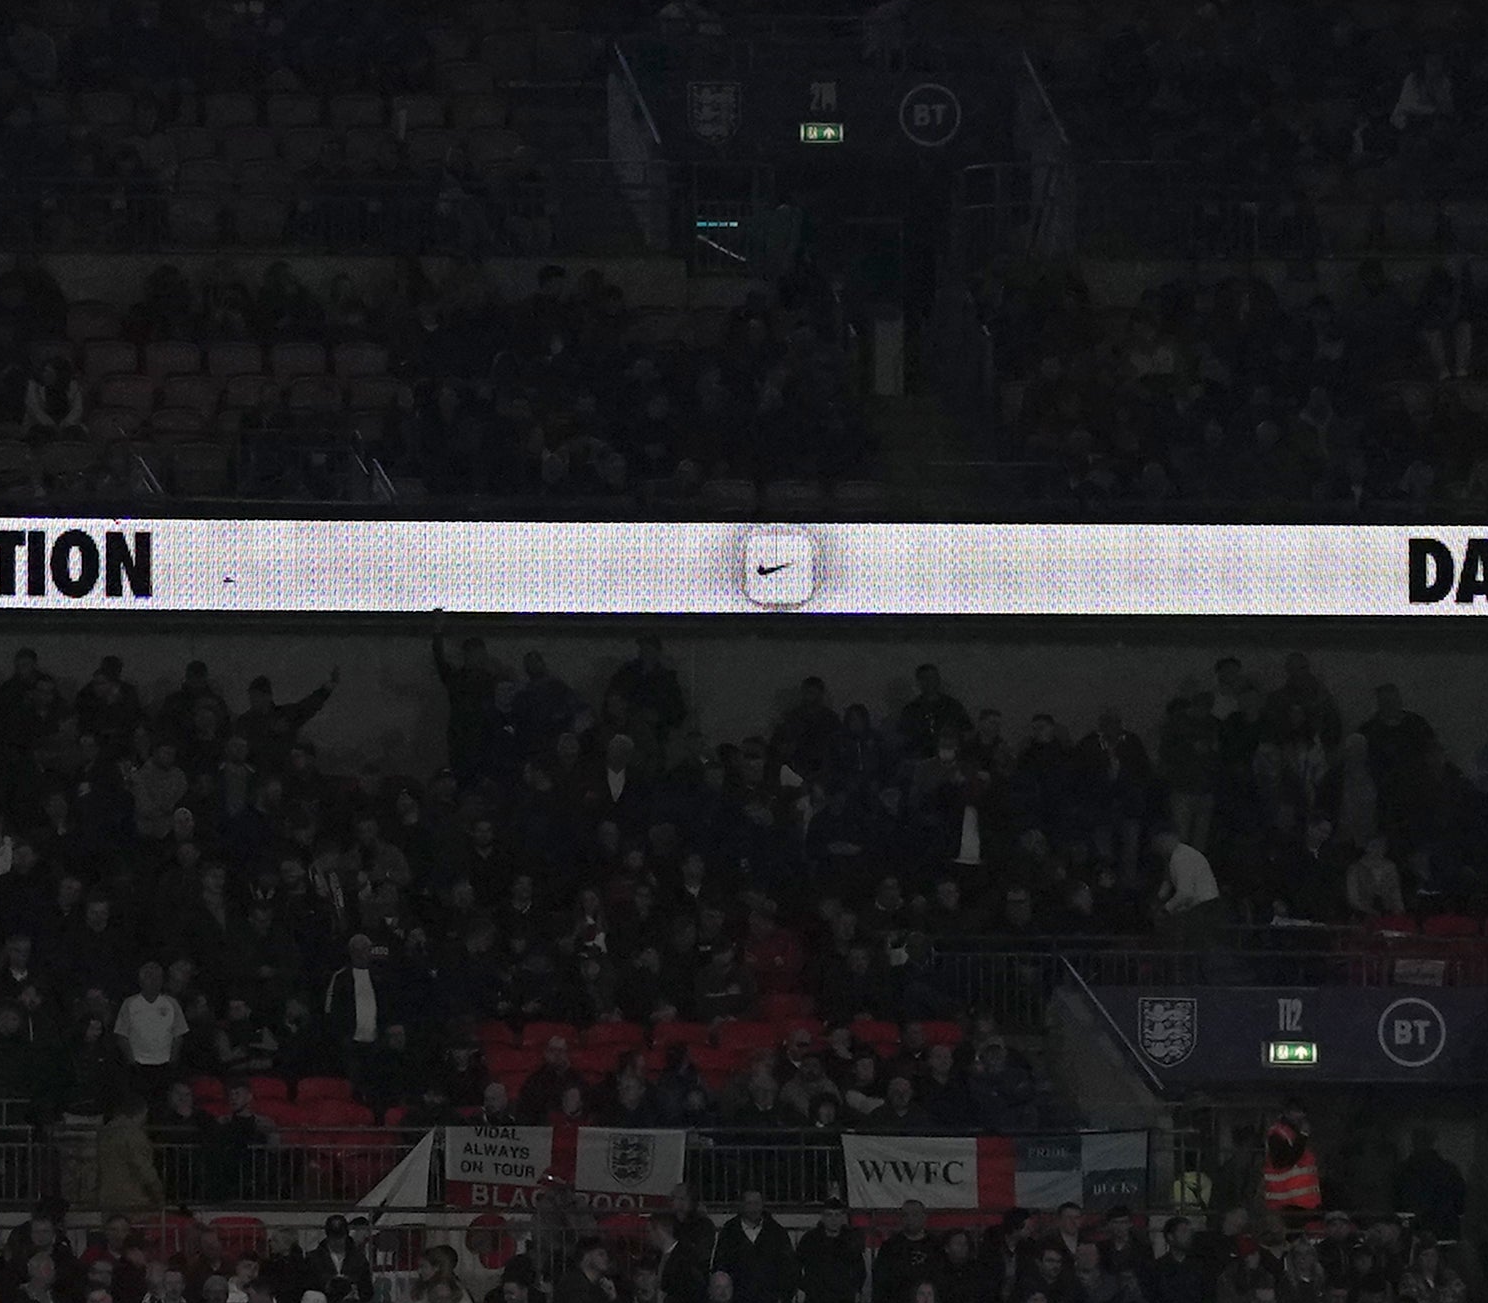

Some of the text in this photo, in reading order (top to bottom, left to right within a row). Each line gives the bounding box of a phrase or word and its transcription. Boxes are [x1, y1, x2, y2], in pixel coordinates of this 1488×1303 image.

[913, 104, 947, 126] BT
[1393, 1019, 1432, 1046] BT
[473, 1126, 520, 1141] VIDAL
[463, 1142, 530, 1159] ALWAYS
[460, 1160, 536, 1179] ON TOUR
[858, 1160, 965, 1186] WWFC
